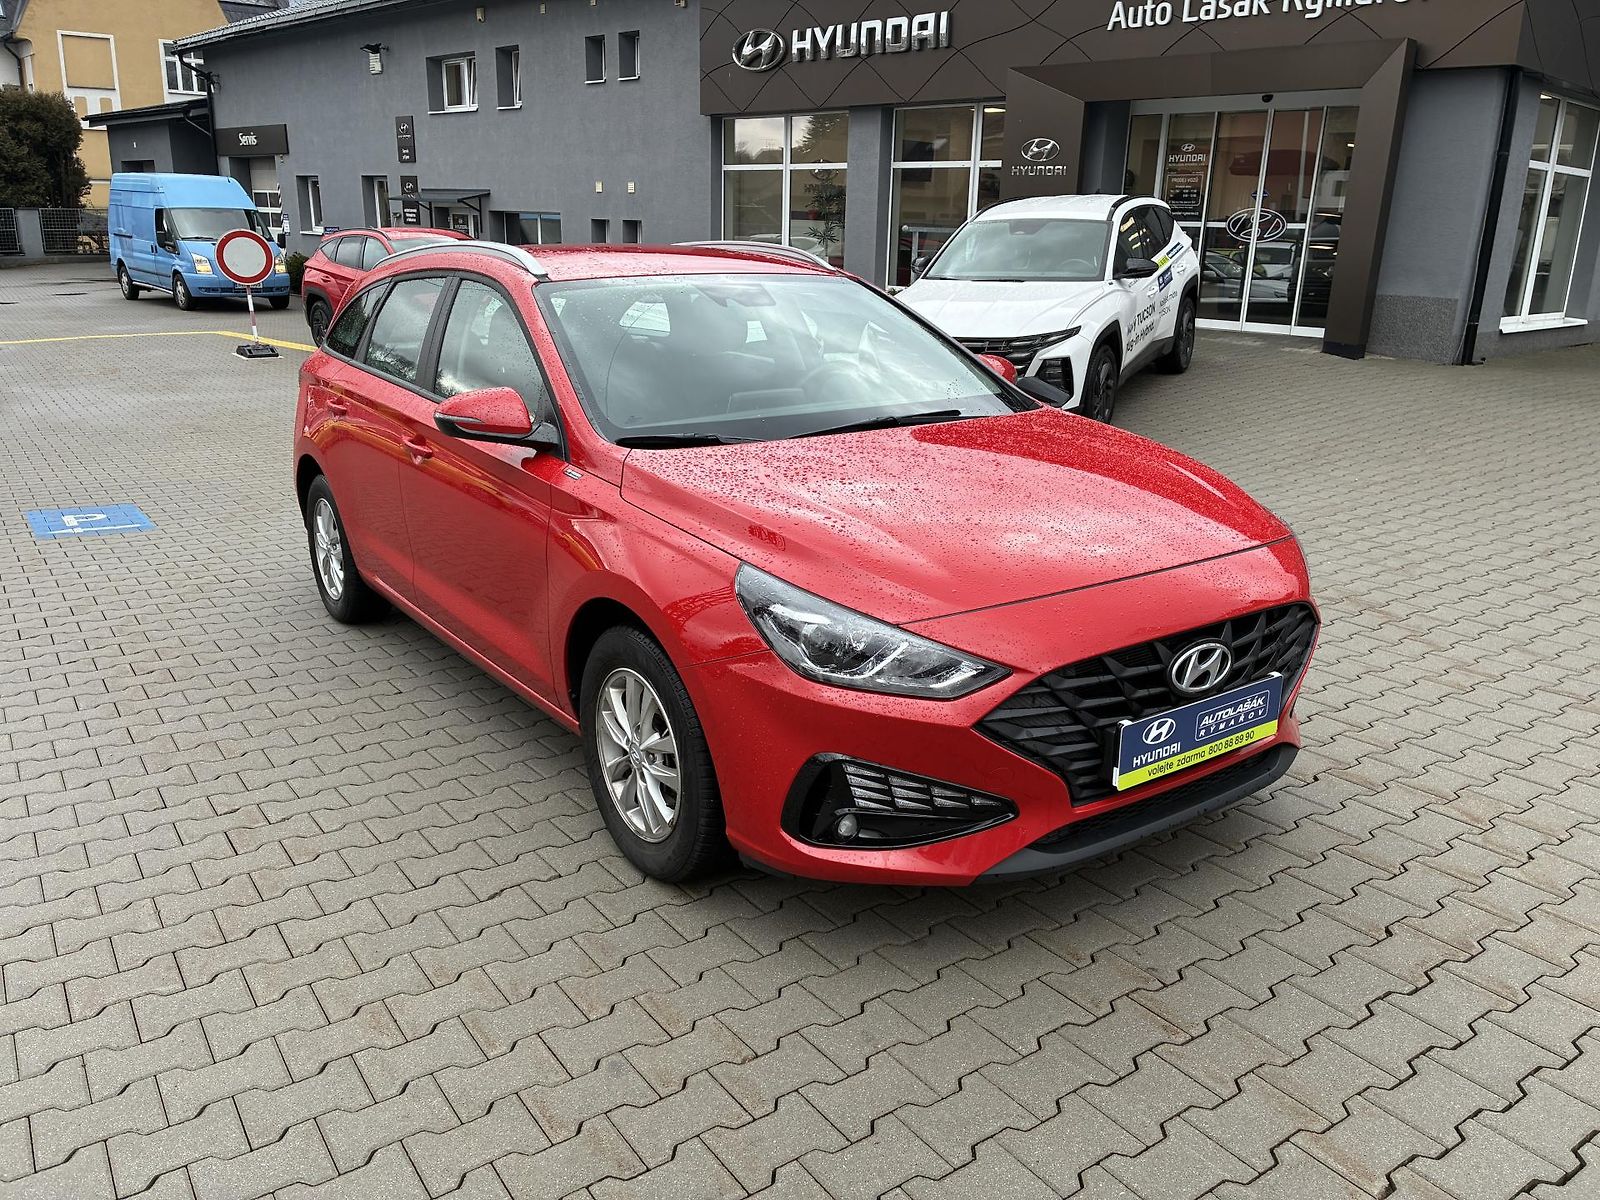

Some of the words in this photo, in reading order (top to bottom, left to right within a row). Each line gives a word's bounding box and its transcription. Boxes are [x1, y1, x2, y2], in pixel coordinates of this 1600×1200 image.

[1107, 0, 1173, 31] Auto
[791, 11, 949, 62] HYUNDAI
[239, 131, 258, 146] Servis
[1011, 165, 1067, 176] HYUNDAI
[1168, 153, 1207, 163] HYUNDAI
[1200, 696, 1266, 727] AUTOLAŠÁK
[1132, 742, 1181, 768] HYUNDAI
[1147, 760, 1174, 777] volejte
[1176, 751, 1206, 767] zdarma
[1208, 743, 1224, 755] 800
[1223, 737, 1234, 749] 88
[1234, 734, 1244, 745] 89
[1244, 730, 1255, 742] 90
